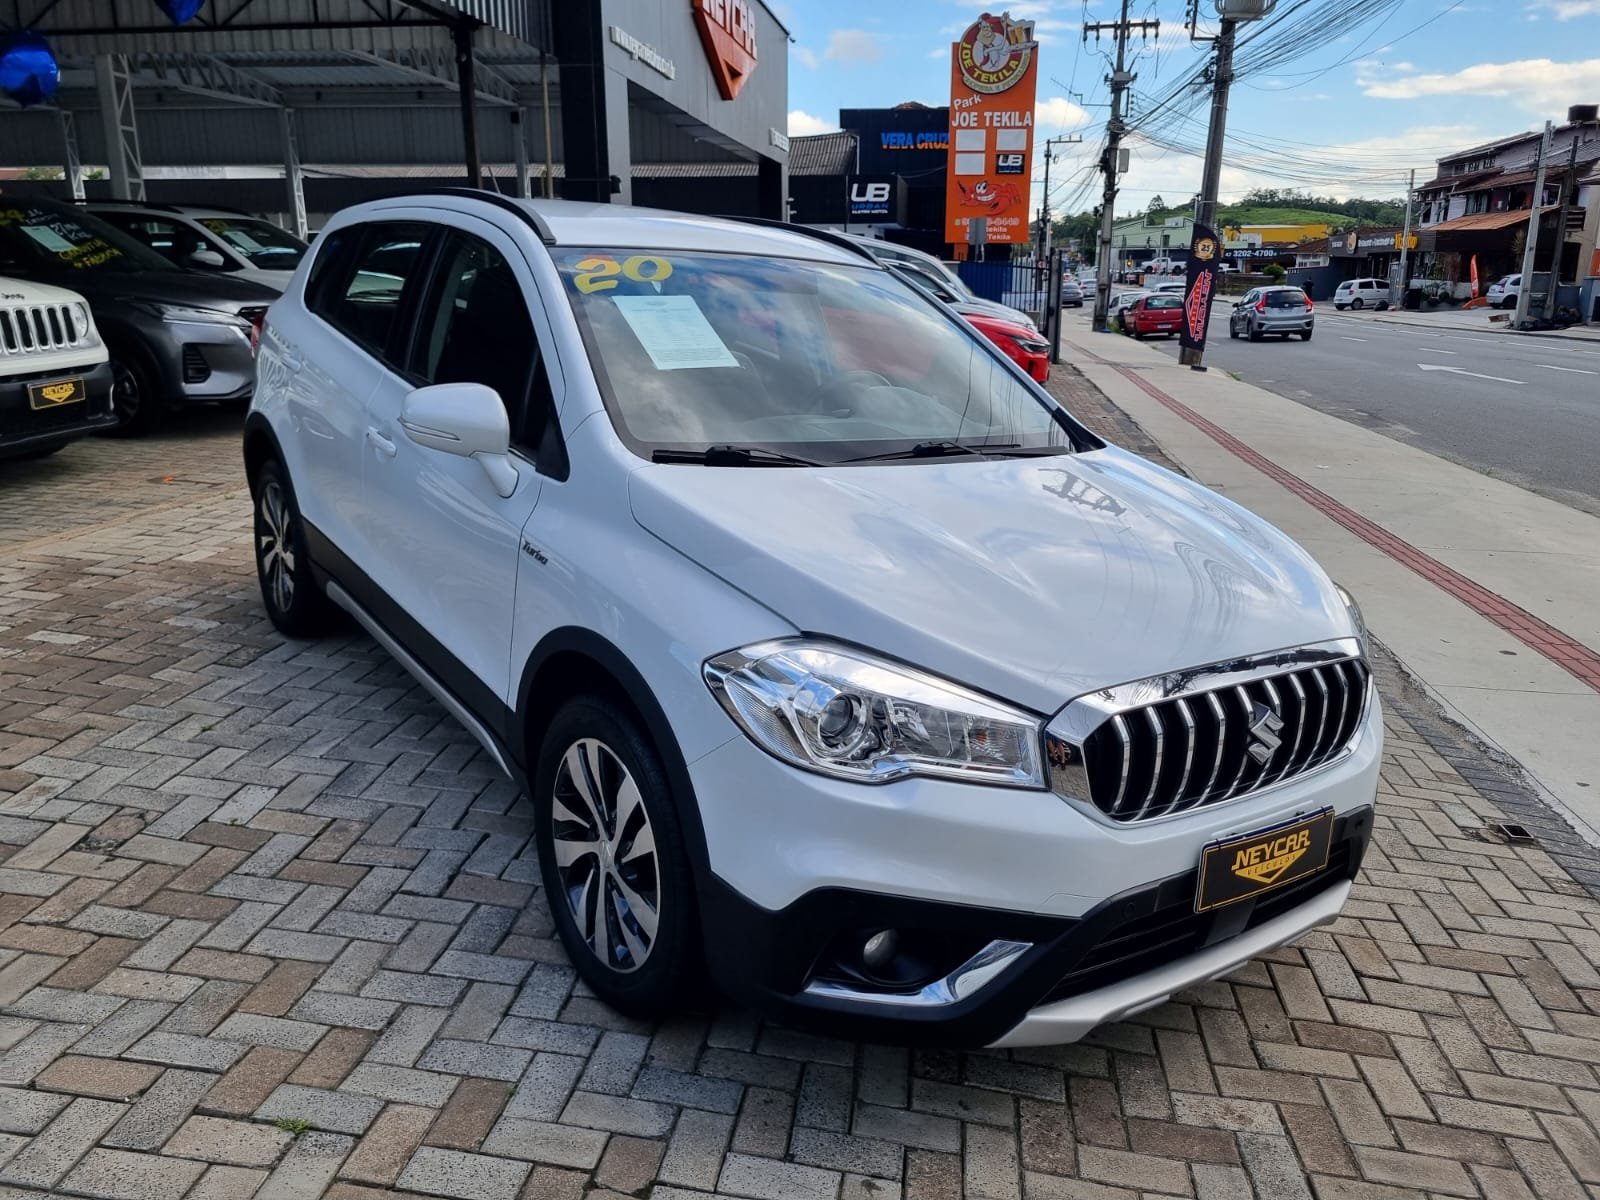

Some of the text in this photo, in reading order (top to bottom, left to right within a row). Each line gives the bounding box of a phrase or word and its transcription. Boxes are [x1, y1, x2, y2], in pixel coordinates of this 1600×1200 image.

[962, 41, 974, 69] JOE
[972, 60, 1019, 83] TEKILA
[953, 94, 982, 110] Park
[951, 111, 1032, 127] JOE TEKILA
[880, 132, 914, 149] VERA
[998, 154, 1023, 166] UB
[851, 182, 891, 202] UB
[1233, 249, 1273, 257] 3202-4700
[573, 255, 673, 294] 20
[522, 540, 549, 566] Turbo
[1231, 828, 1312, 871] NEYCAR
